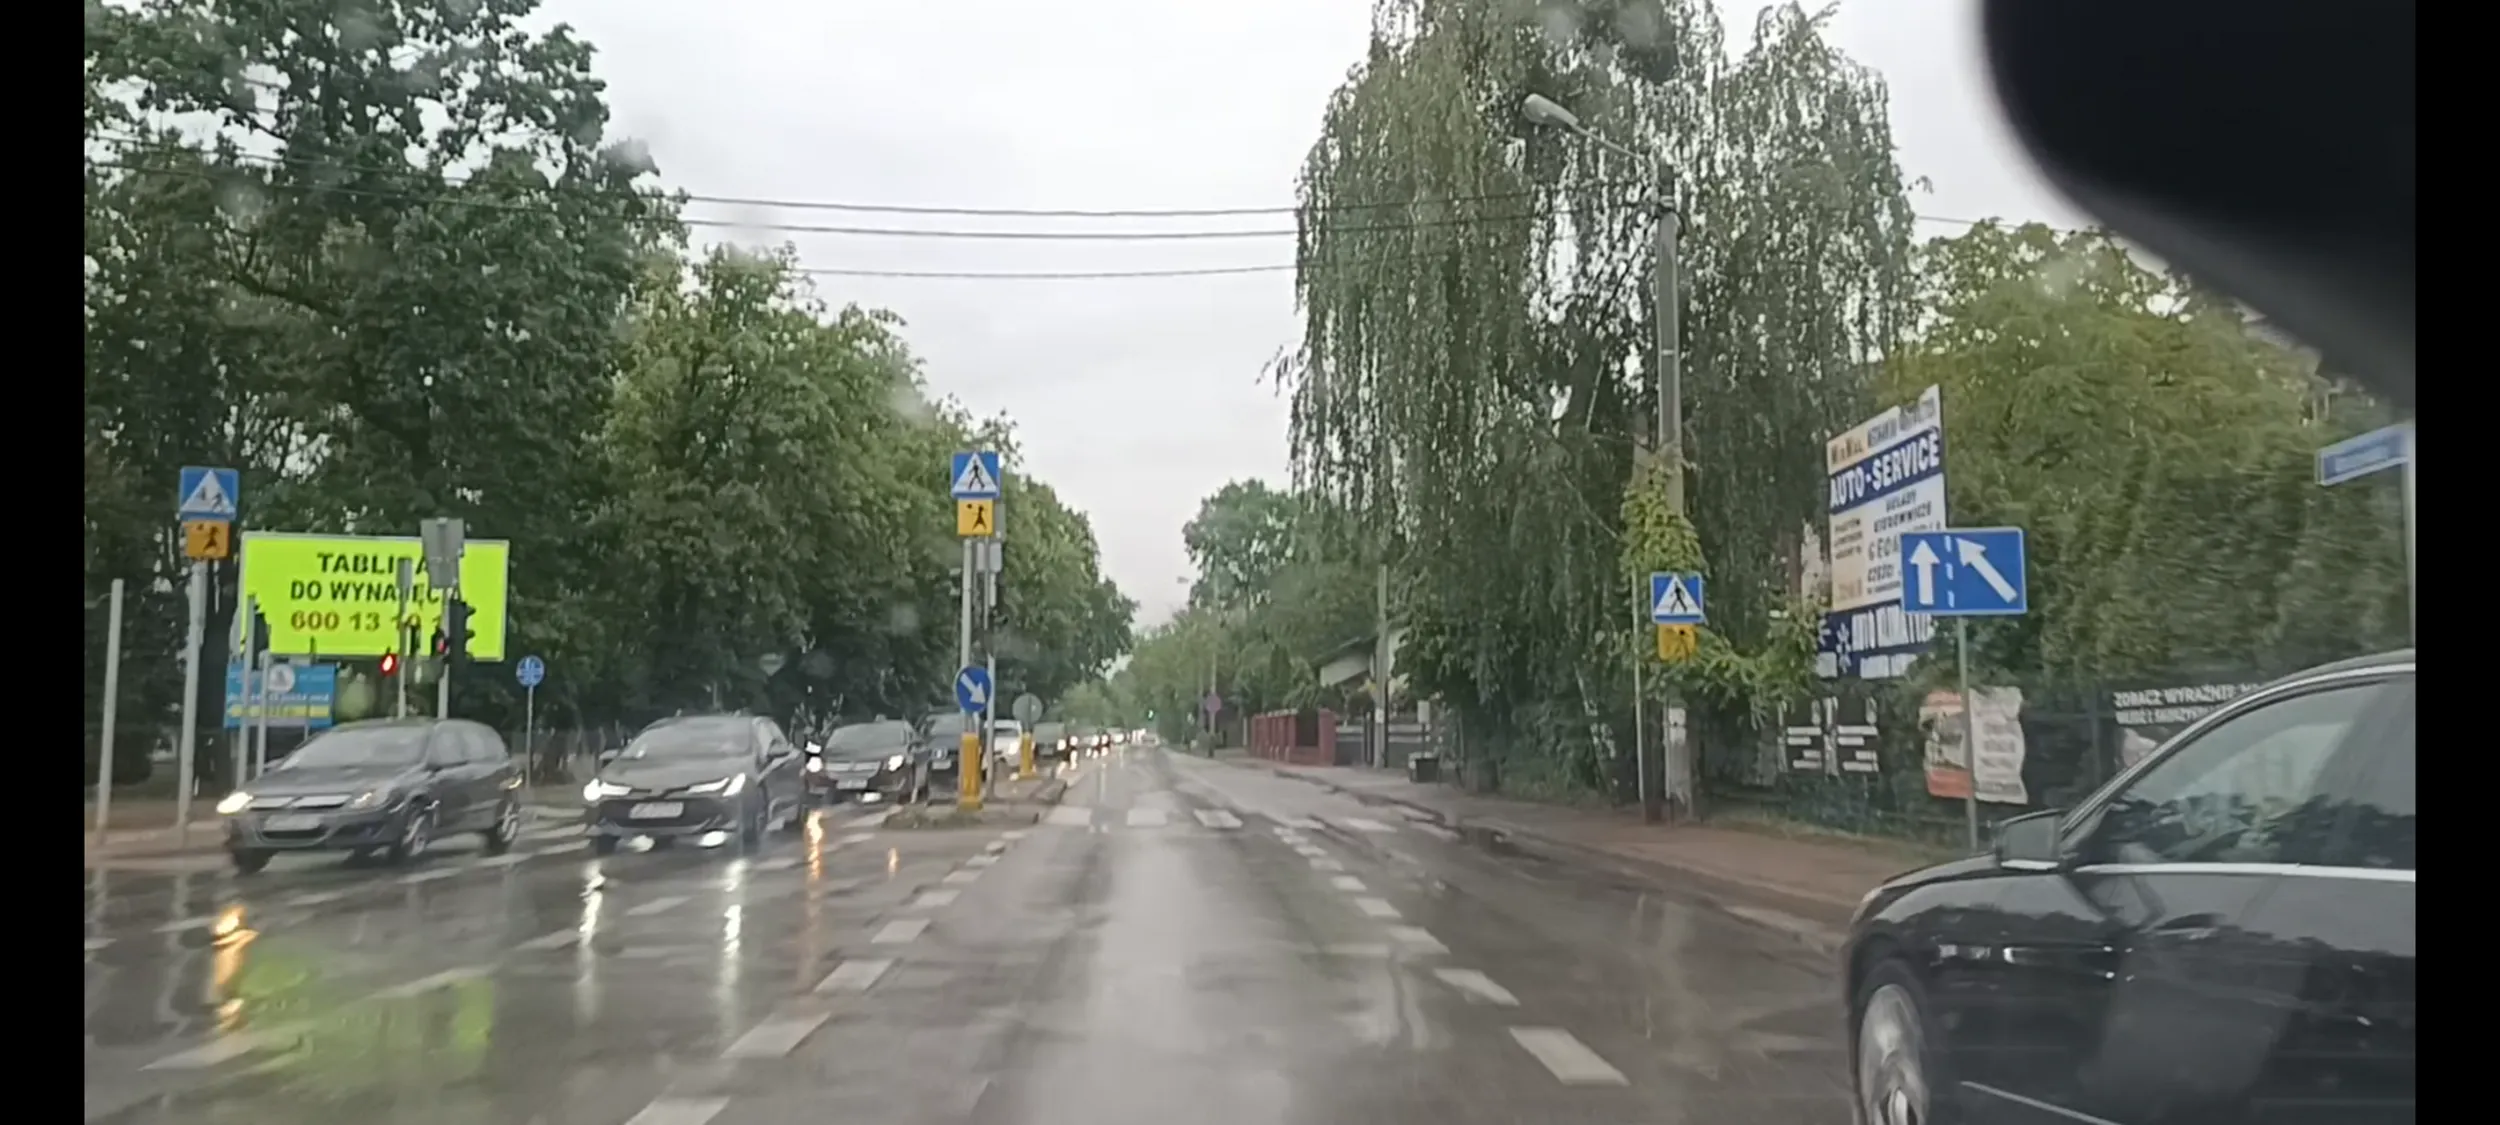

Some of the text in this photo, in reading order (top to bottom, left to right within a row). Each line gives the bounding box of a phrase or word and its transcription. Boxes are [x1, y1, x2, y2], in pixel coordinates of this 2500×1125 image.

[316, 551, 430, 574] TABLIA
[290, 579, 322, 601] DO
[291, 610, 340, 632] 600
[349, 611, 380, 631] 13
